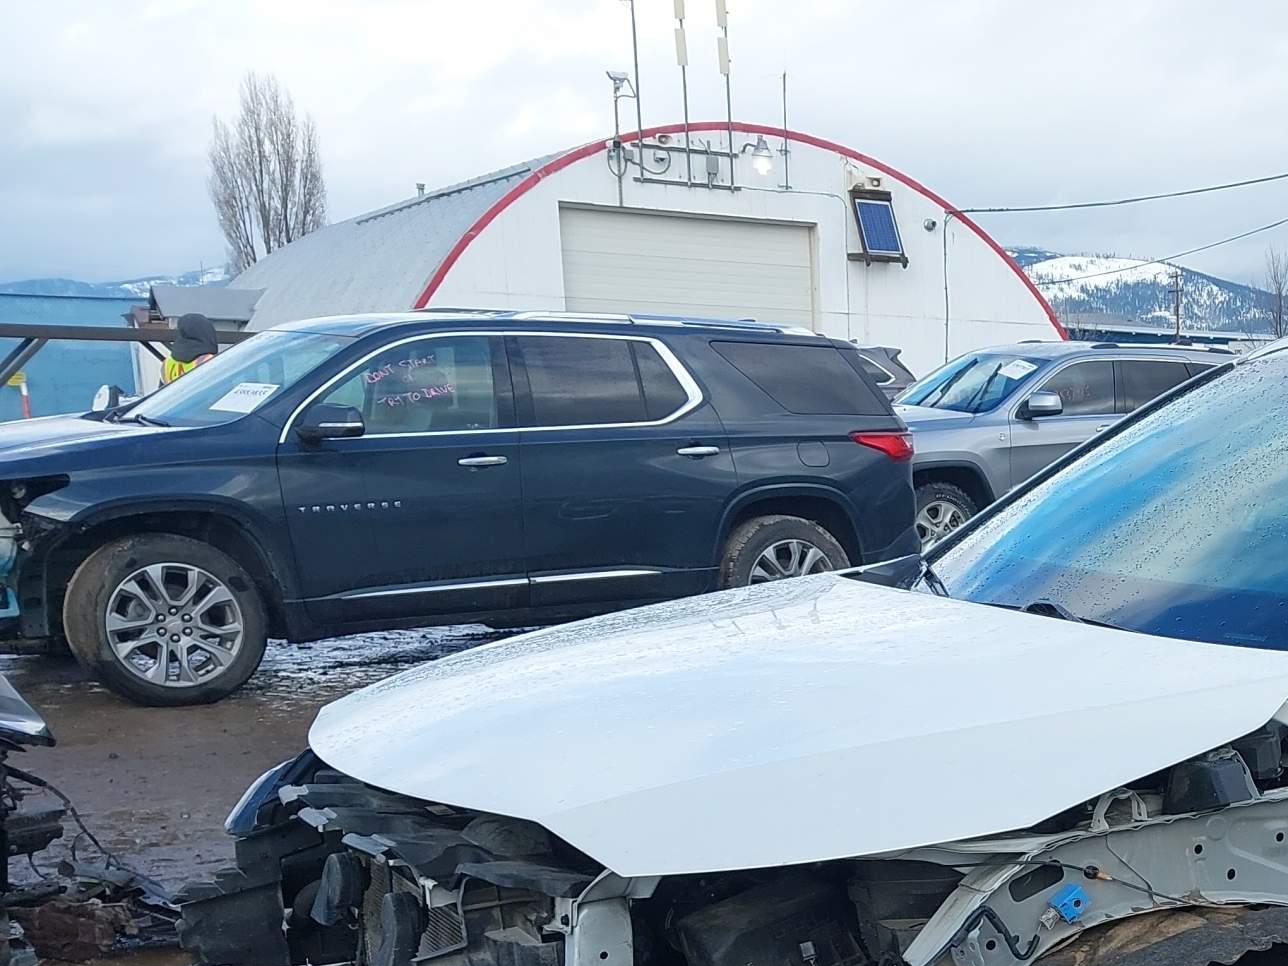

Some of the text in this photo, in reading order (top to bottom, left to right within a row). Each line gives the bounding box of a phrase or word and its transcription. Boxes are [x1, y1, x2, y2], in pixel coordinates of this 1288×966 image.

[398, 355, 434, 370] START
[377, 383, 456, 407] TRY TO DRIVE
[298, 500, 401, 513] TRAVERSE
